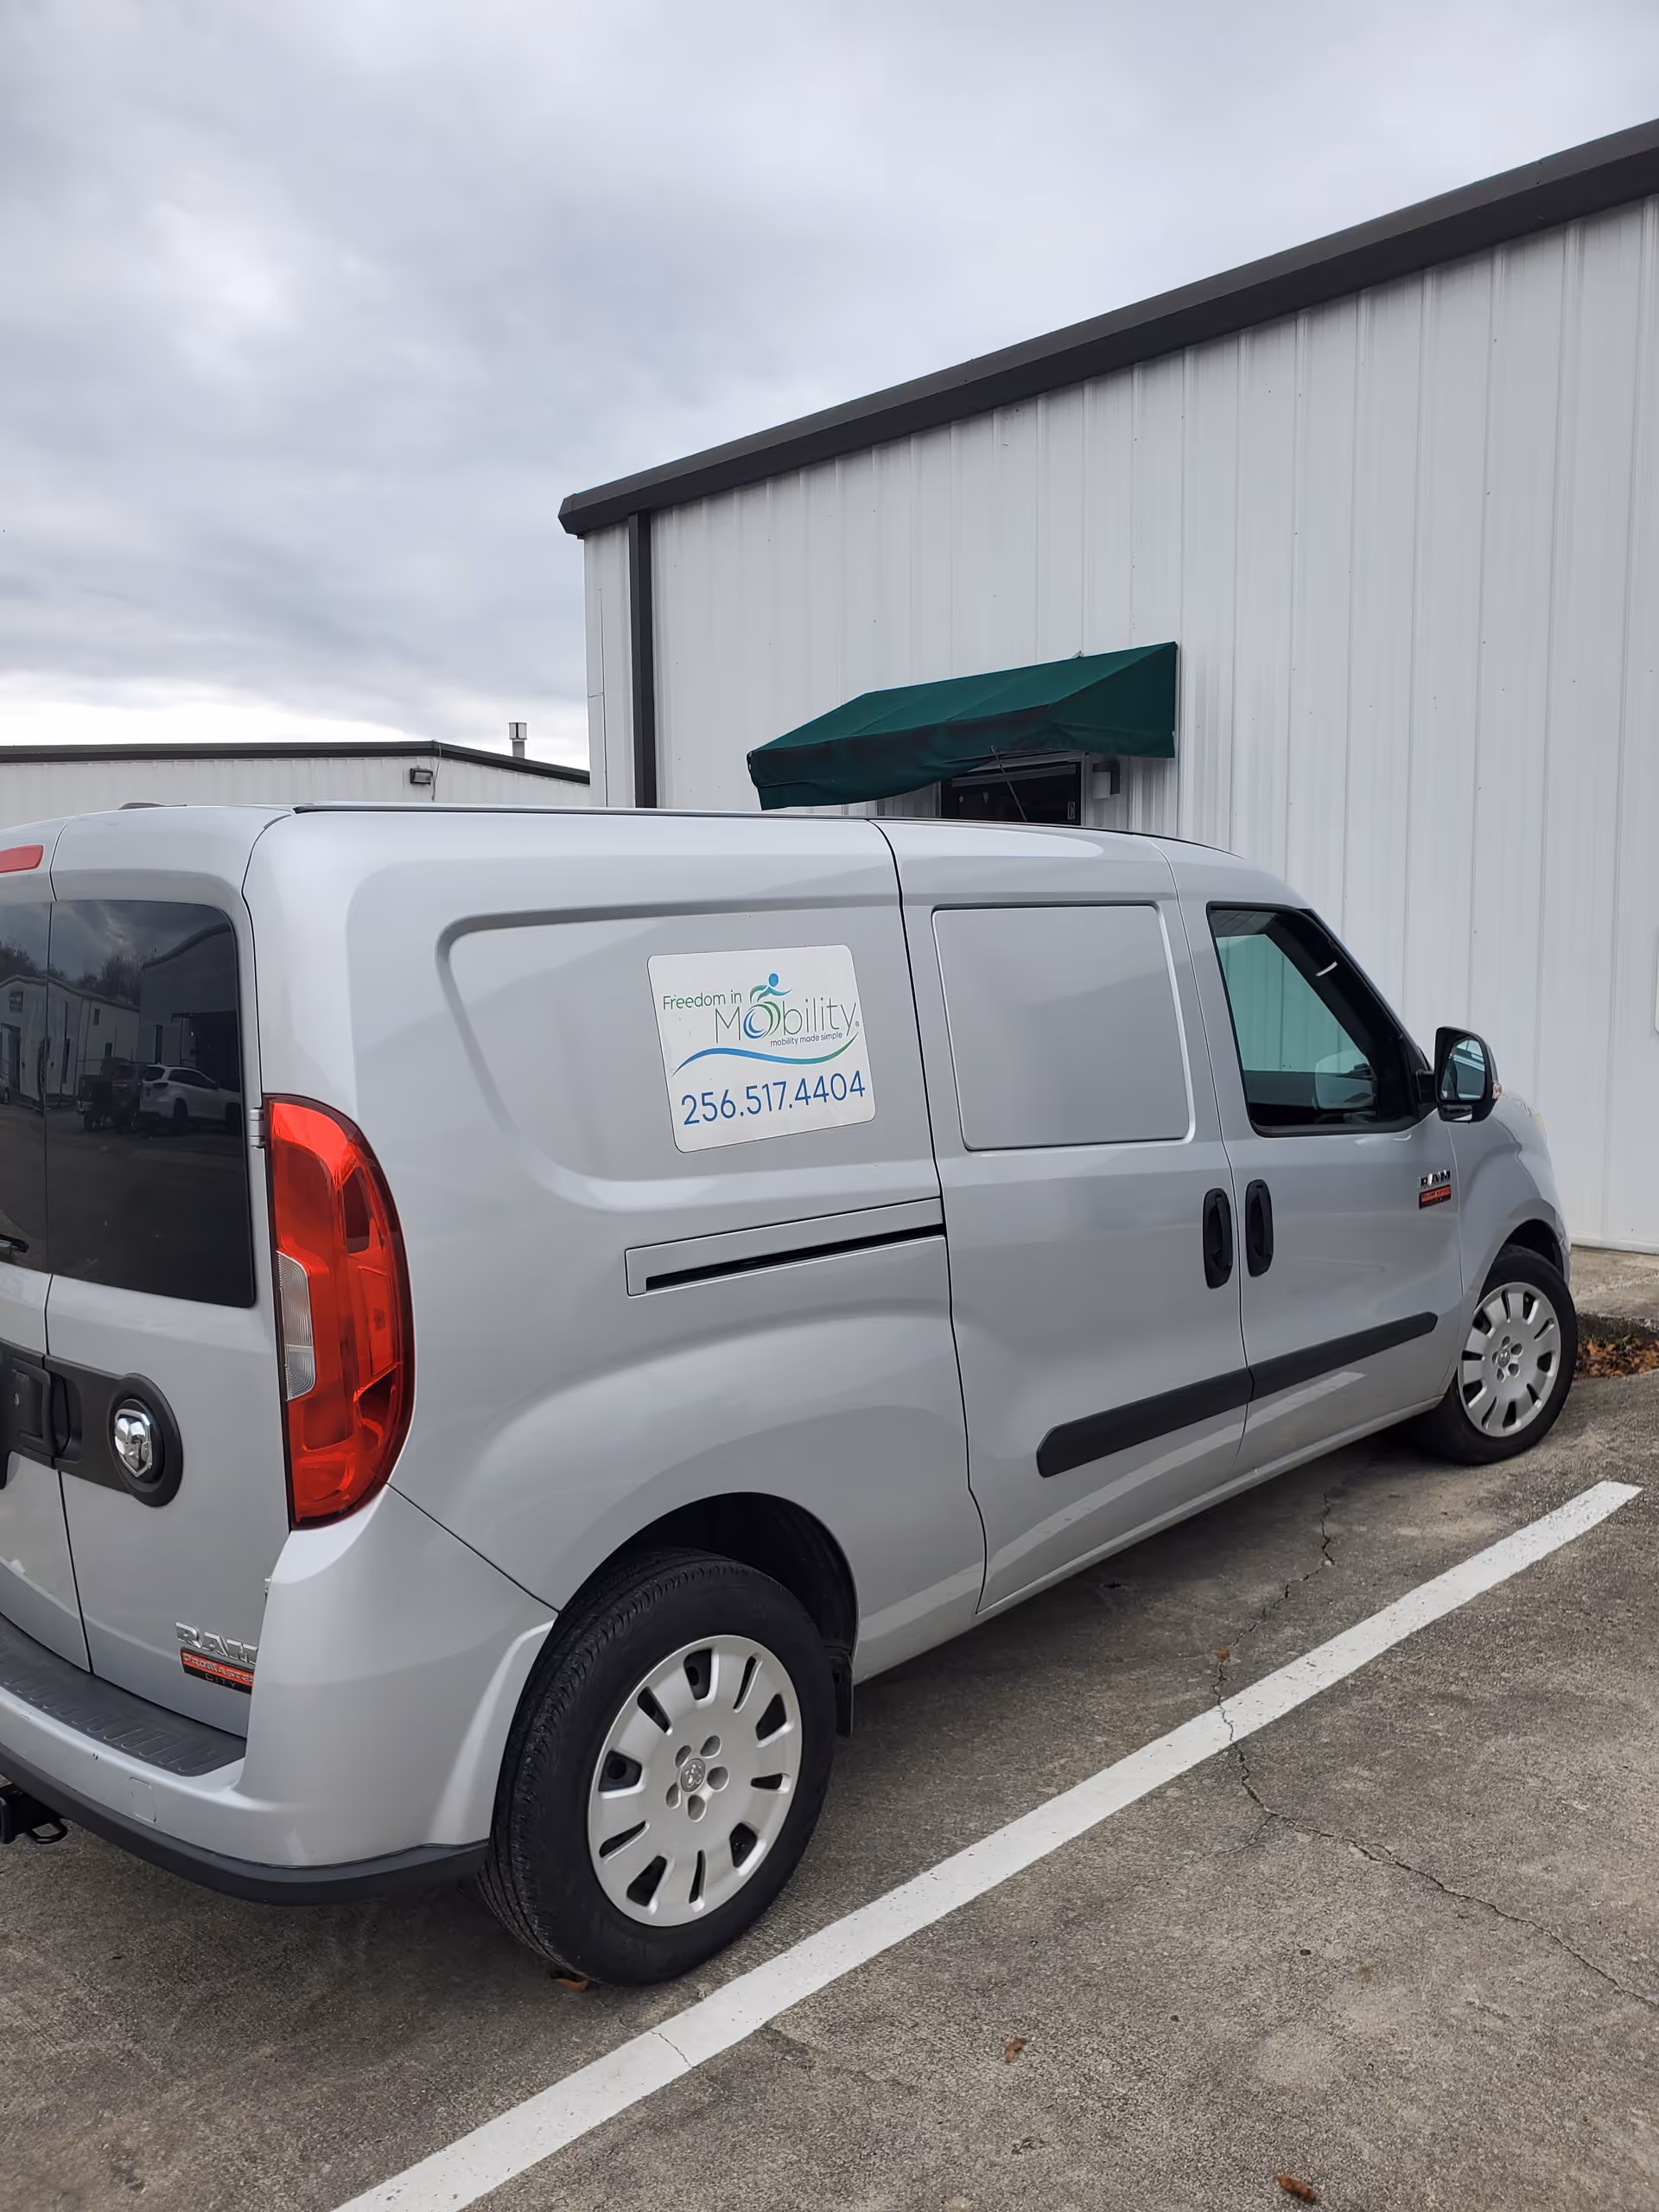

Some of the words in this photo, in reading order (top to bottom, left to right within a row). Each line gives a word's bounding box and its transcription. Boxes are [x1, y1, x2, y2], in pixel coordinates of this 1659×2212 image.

[663, 992, 726, 1010] Freedom
[730, 989, 742, 1004] in
[770, 1036, 798, 1047] mobility
[820, 1032, 843, 1041] simple
[681, 1070, 866, 1126] 256.517.4404
[1418, 1169, 1451, 1189] RAM
[175, 1621, 258, 1666] RAM
[205, 1673, 236, 1688] CITY
